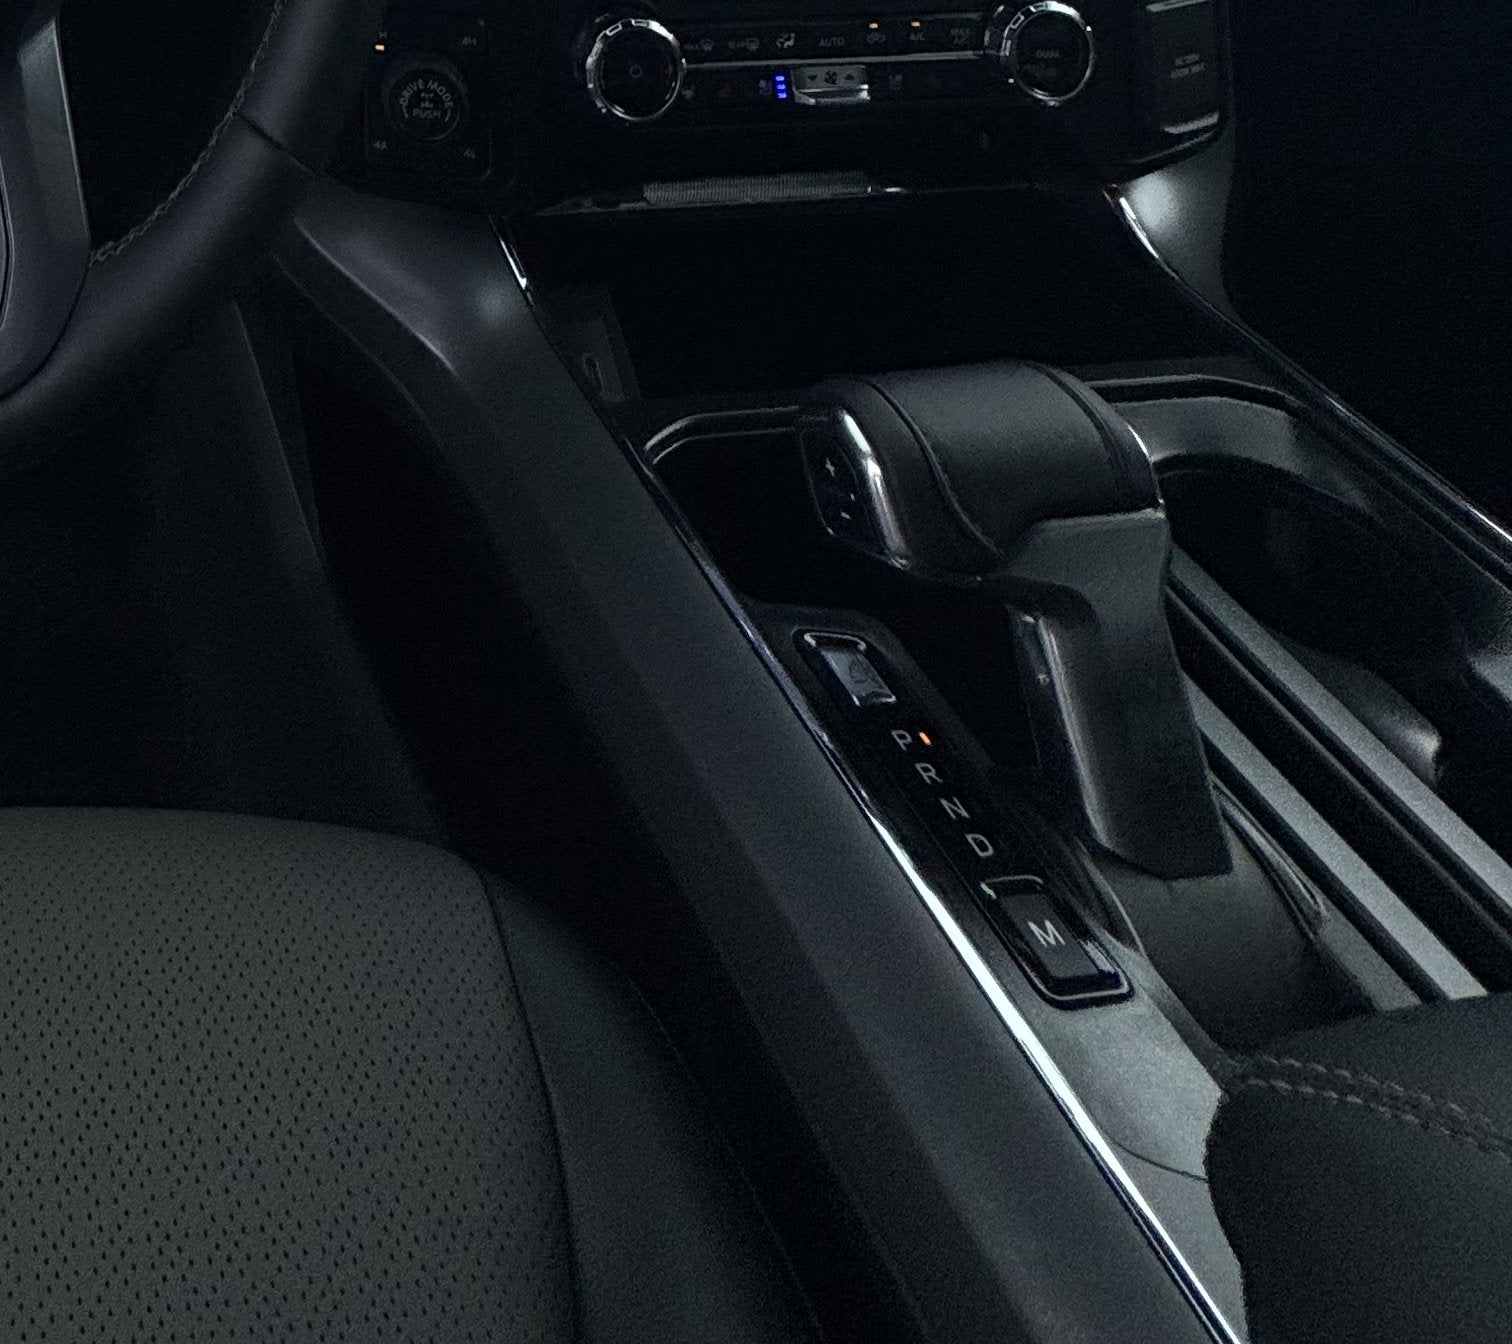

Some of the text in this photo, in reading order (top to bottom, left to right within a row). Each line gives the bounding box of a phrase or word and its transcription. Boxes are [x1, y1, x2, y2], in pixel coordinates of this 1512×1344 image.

[819, 36, 845, 48] AUTO
[399, 78, 454, 109] DRIVE MODE
[412, 108, 441, 119] PUSH
[891, 729, 914, 751] P
[916, 763, 943, 784] R
[939, 797, 971, 821] N
[966, 833, 994, 858] D
[1027, 919, 1065, 948] M
